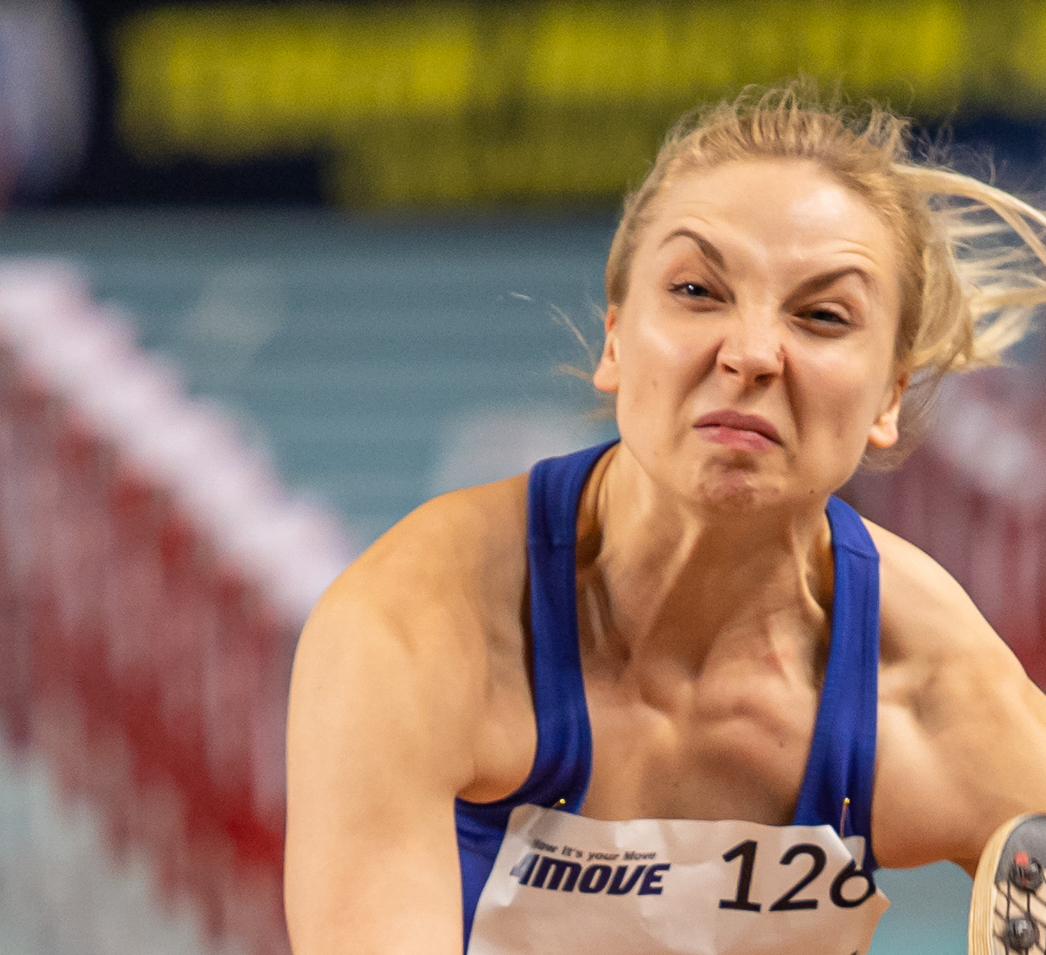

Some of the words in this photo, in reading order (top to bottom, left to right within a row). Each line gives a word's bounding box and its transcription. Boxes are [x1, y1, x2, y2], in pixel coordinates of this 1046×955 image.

[587, 851, 620, 861] your
[623, 851, 657, 861] Move
[718, 838, 877, 913] 126
